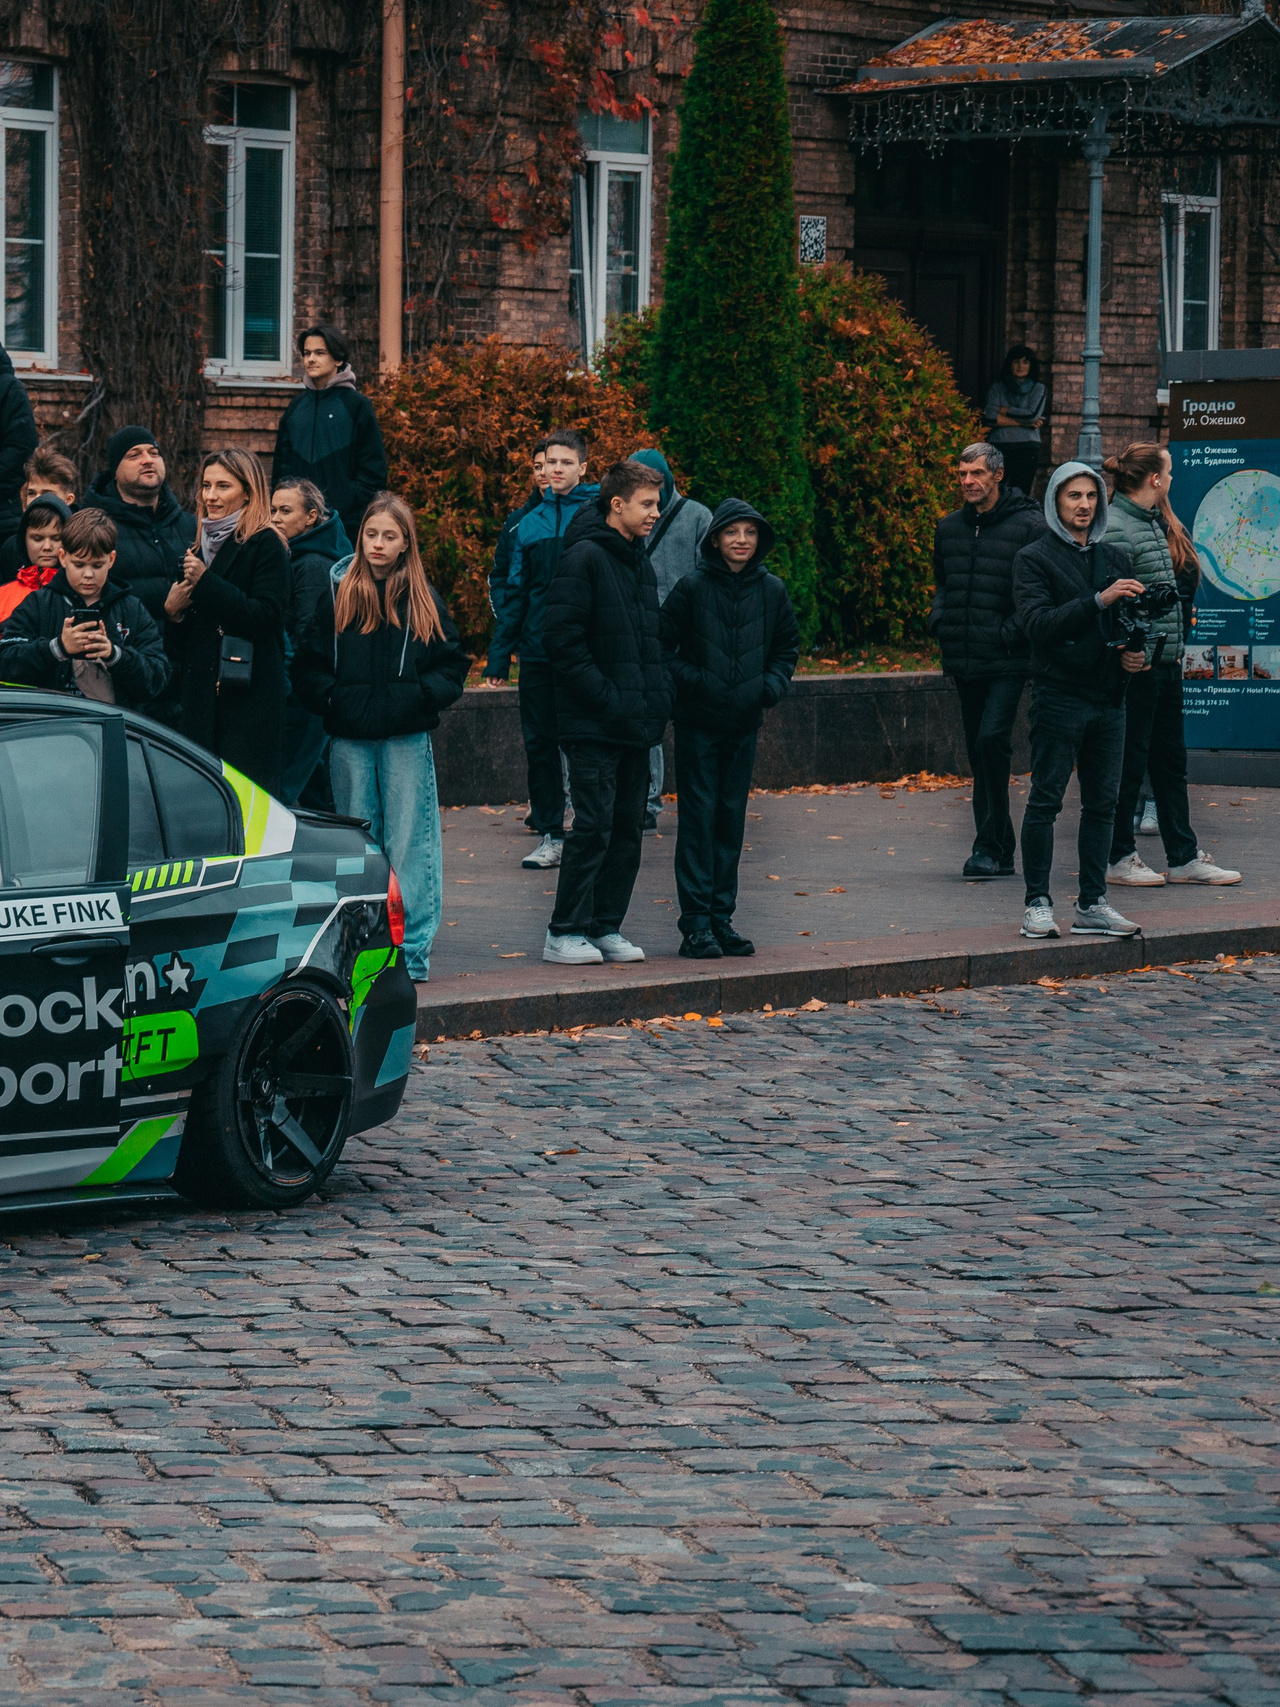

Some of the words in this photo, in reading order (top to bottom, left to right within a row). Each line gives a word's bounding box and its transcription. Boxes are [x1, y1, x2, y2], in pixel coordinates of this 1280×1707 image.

[1182, 399, 1236, 415] Гродно
[1183, 417, 1198, 428] ул.
[1200, 415, 1246, 425] Ожешко
[1191, 448, 1202, 456] ул.
[1204, 446, 1238, 454] Ожешко
[1191, 458, 1202, 466] ул.
[1204, 457, 1245, 466] Буденного
[53, 899, 115, 924] FINK
